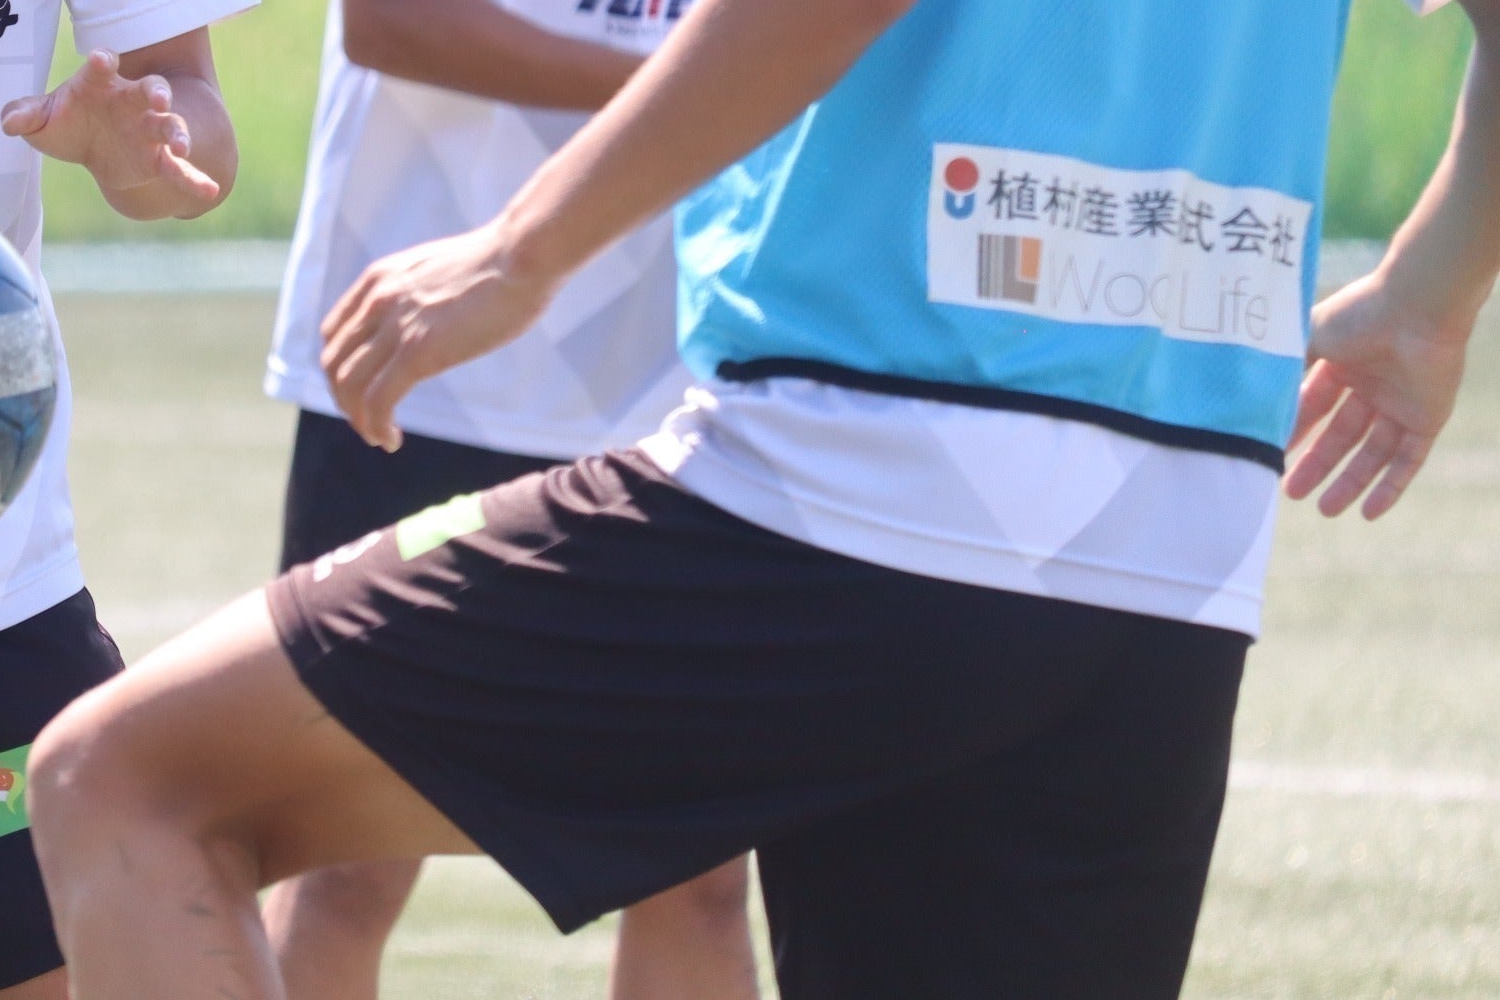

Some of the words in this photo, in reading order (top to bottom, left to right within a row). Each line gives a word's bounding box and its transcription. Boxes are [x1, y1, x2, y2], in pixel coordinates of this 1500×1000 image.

[987, 168, 1294, 267] 植村産業式会社
